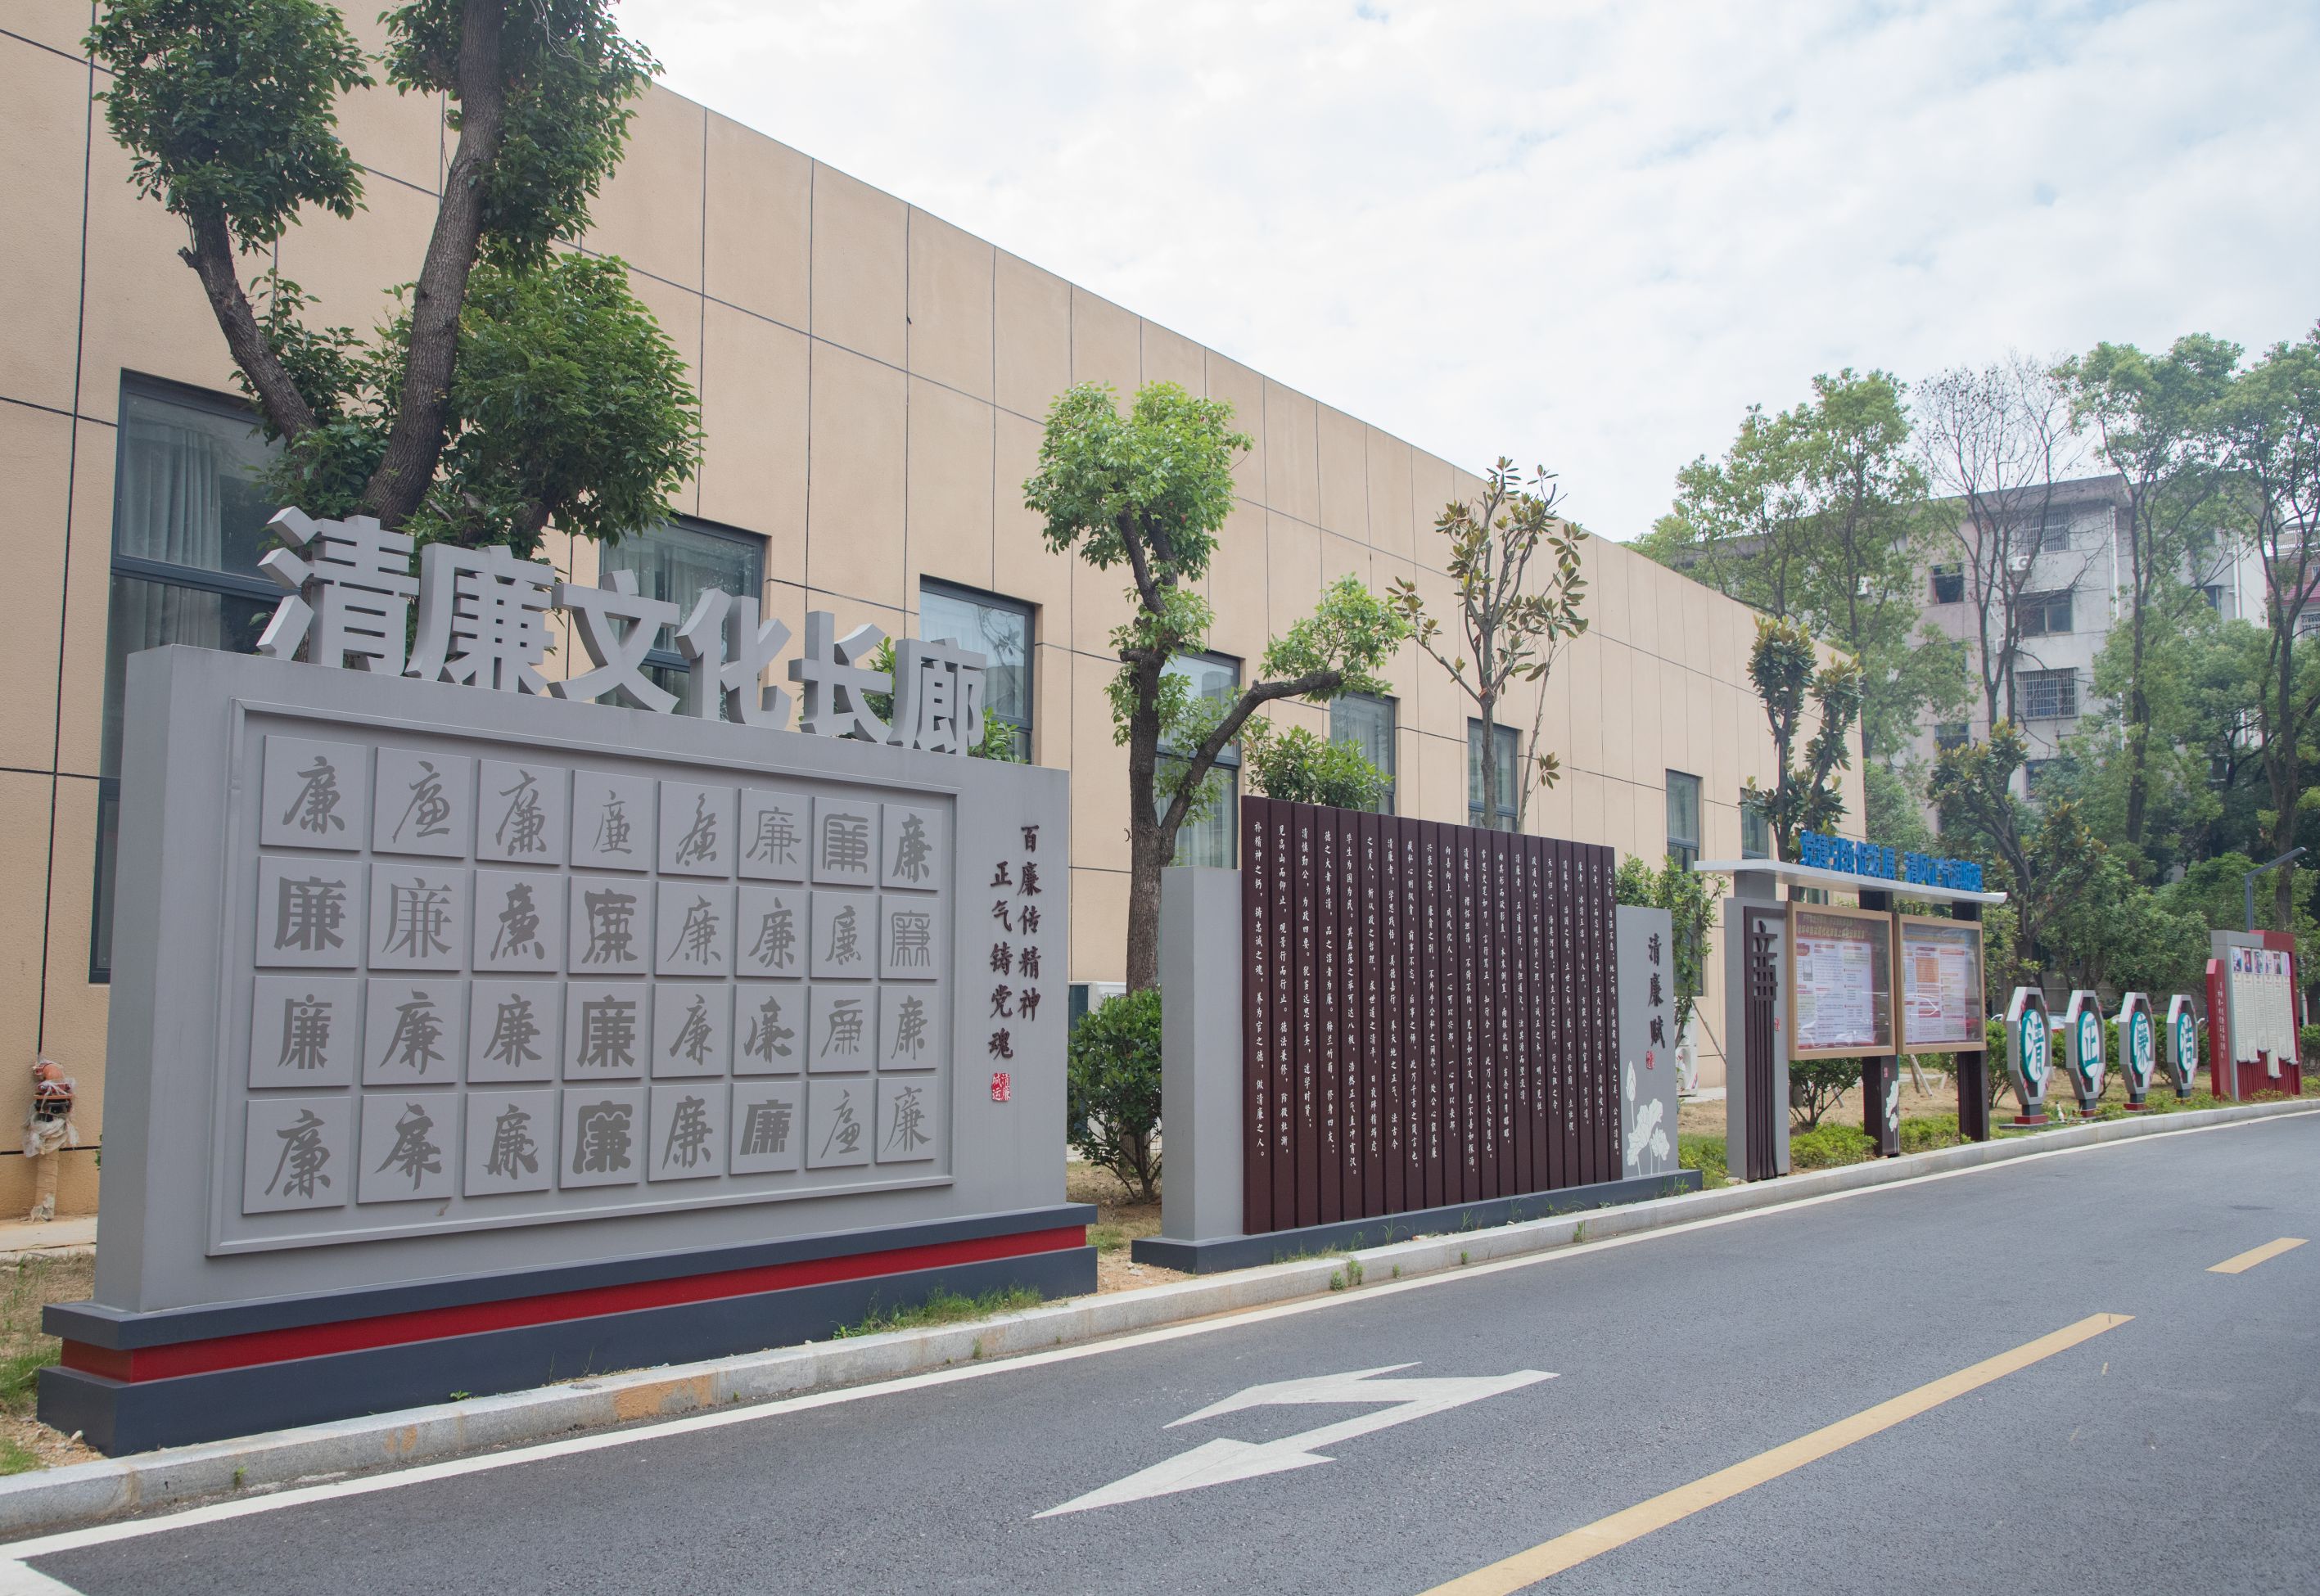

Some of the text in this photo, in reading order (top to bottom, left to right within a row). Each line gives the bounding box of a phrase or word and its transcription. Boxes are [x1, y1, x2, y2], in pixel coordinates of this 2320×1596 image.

[256, 506, 986, 755] 清廉文化长廊
[282, 756, 345, 834] 廉
[392, 761, 450, 843] 廉
[495, 769, 546, 856] 廉
[594, 790, 632, 854] 廉
[746, 806, 801, 864] 廉
[822, 813, 868, 873] 廉
[892, 813, 932, 883] 廉
[1799, 830, 1895, 881] 党建引领促发展
[273, 877, 346, 951] 廉
[382, 877, 452, 958] 廉
[490, 882, 544, 961] 廉
[581, 888, 638, 963] 廉
[667, 895, 721, 965] 廉
[748, 897, 795, 969] 廉
[825, 905, 861, 965] 廉
[890, 910, 931, 967] 廉
[1018, 825, 1042, 1021] 百廉传精神
[988, 860, 1013, 1060] 正气铸党魂
[1648, 933, 1665, 1048] 清廉赋
[278, 994, 332, 1069] 廉
[380, 990, 445, 1075] 廉
[483, 994, 542, 1067] 廉
[576, 994, 636, 1067] 廉
[669, 994, 712, 1066] 廉
[743, 996, 795, 1063] 廉
[820, 999, 863, 1057] 廉
[891, 995, 928, 1060] 廉
[2023, 1013, 2046, 1076] 清
[2084, 1017, 2100, 1066] 正
[2133, 1014, 2150, 1069] 廉
[2179, 1015, 2194, 1068] 洁
[264, 1109, 331, 1199] 廉
[375, 1102, 442, 1191] 廉
[483, 1104, 538, 1180] 廉
[572, 1101, 633, 1174] 廉
[662, 1095, 713, 1170] 廉
[740, 1099, 792, 1155] 廉
[820, 1089, 860, 1158] 廉
[883, 1086, 931, 1152] 廉
